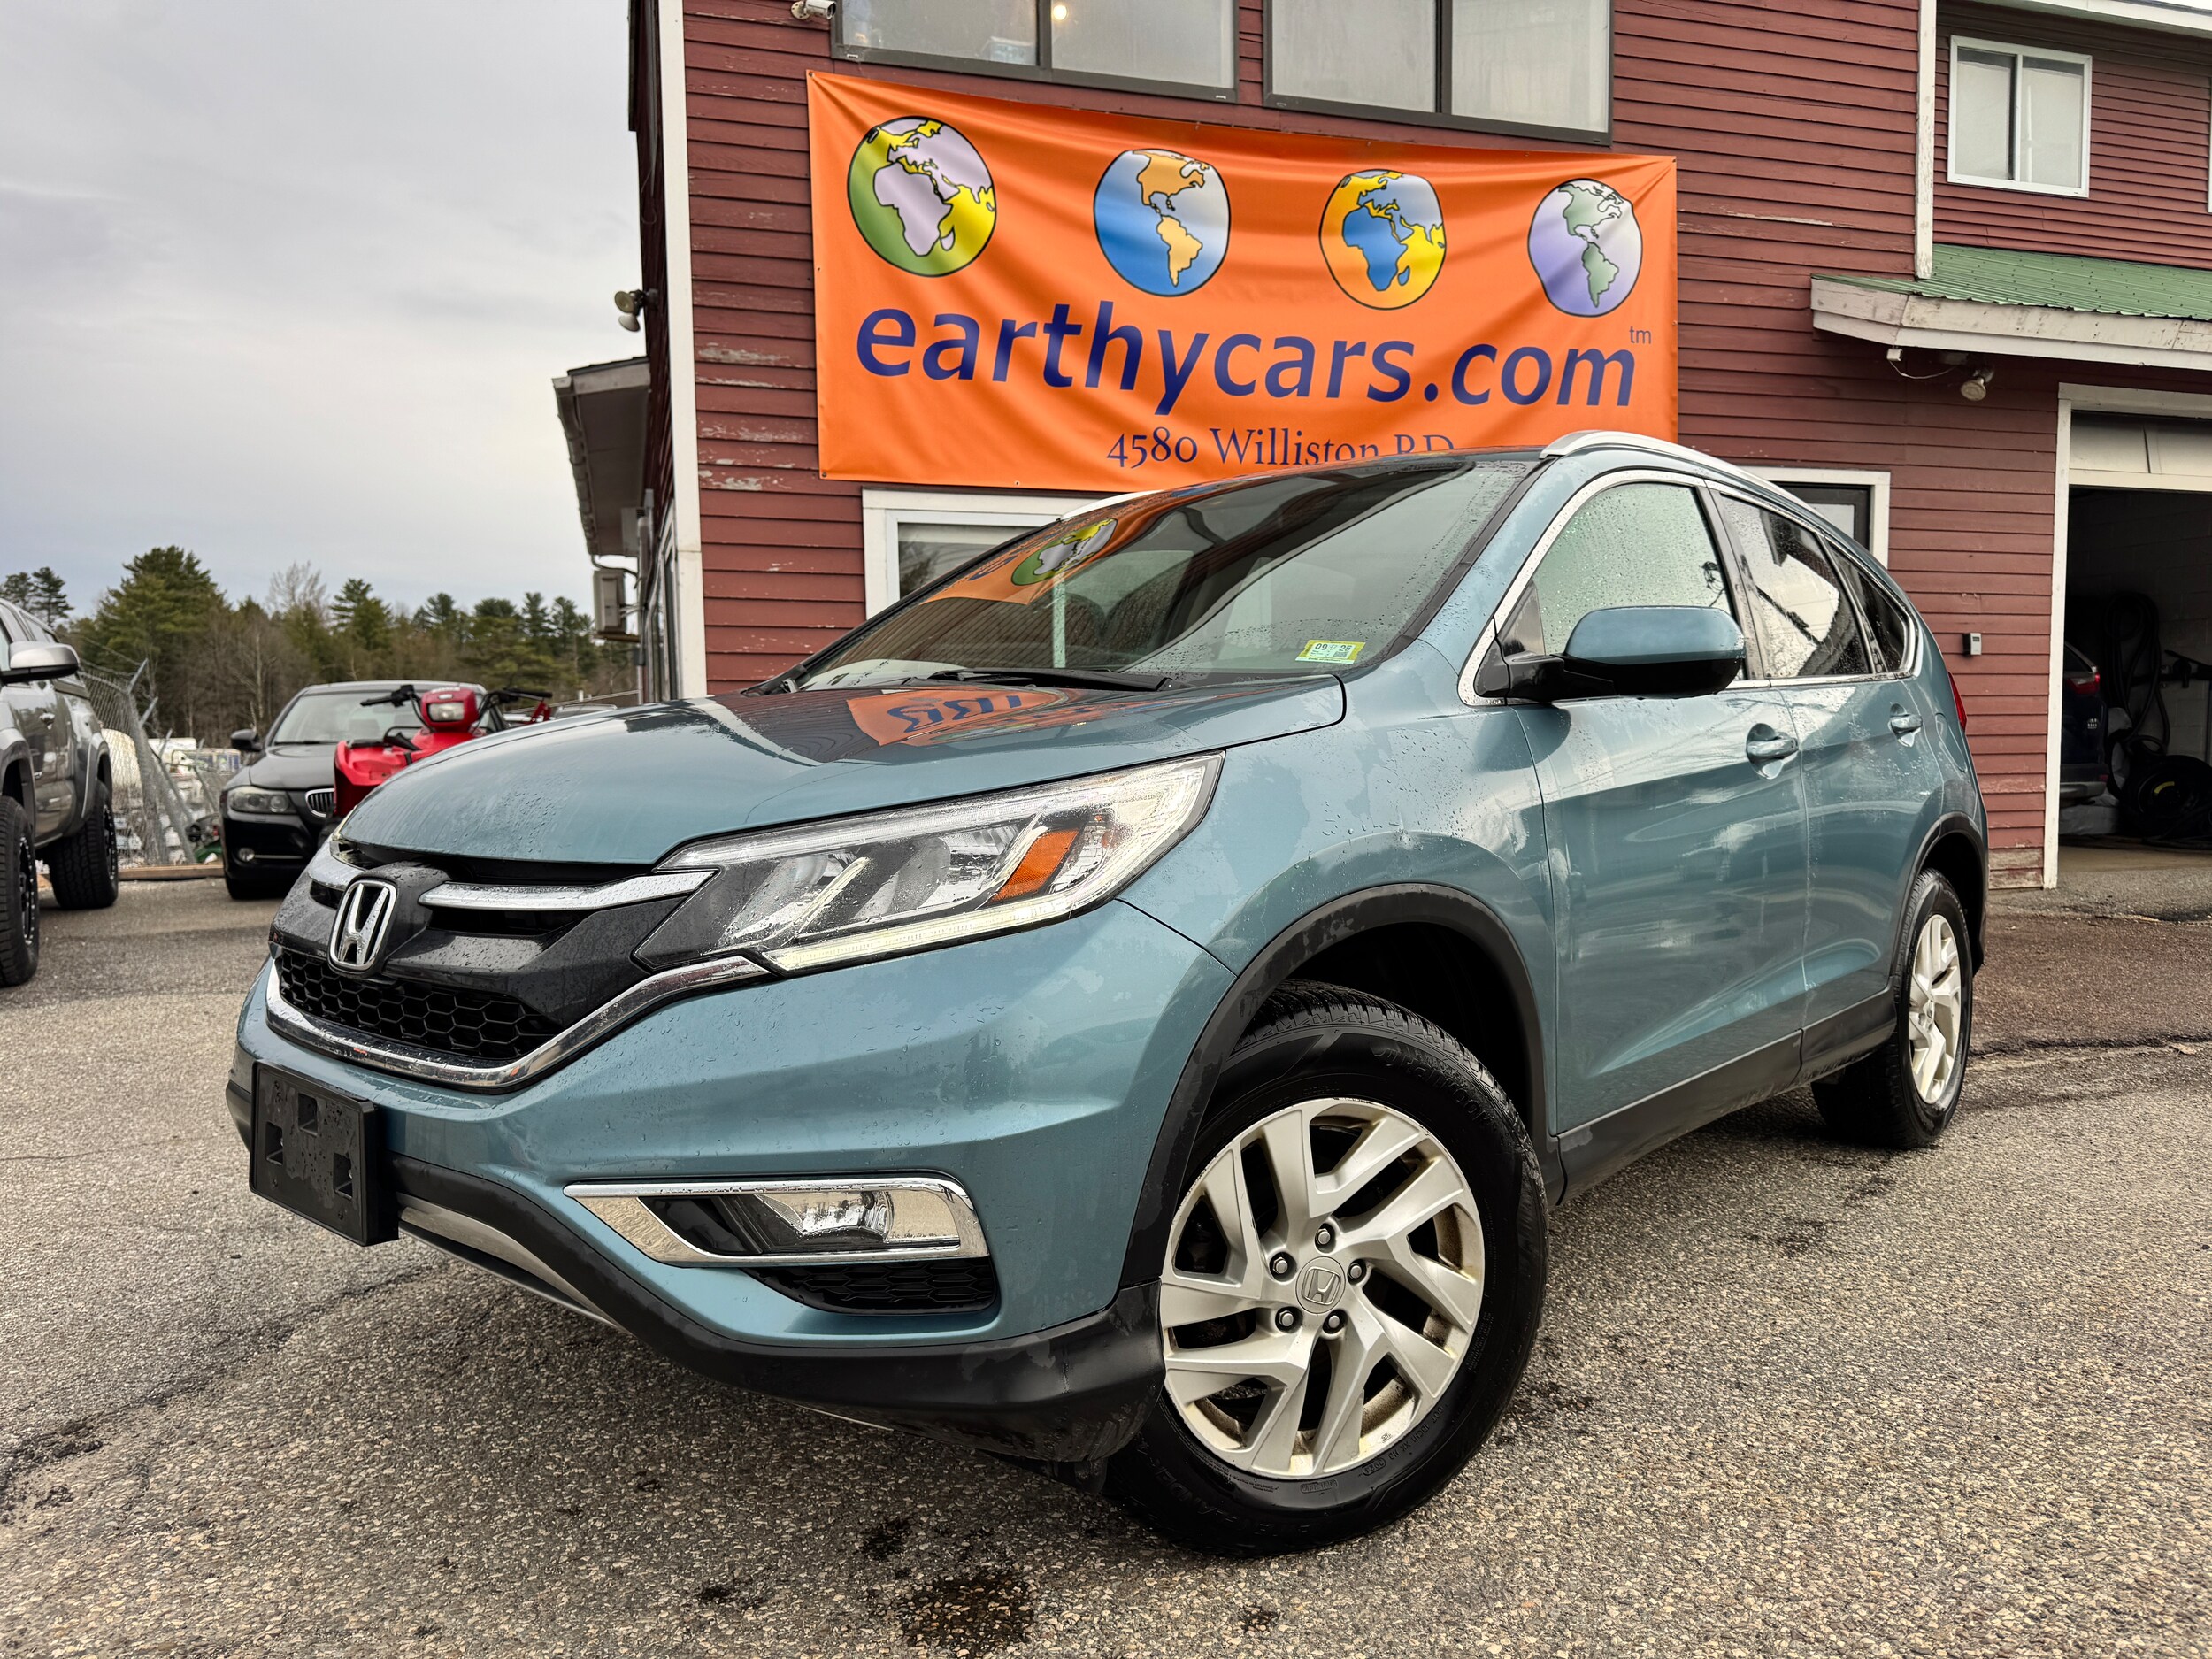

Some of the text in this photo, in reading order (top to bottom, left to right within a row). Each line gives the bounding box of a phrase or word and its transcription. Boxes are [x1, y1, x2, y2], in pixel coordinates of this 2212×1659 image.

[856, 300, 1652, 416] earthycars.com tm
[1106, 426, 1198, 469] 4580
[1209, 427, 1379, 465] Williston
